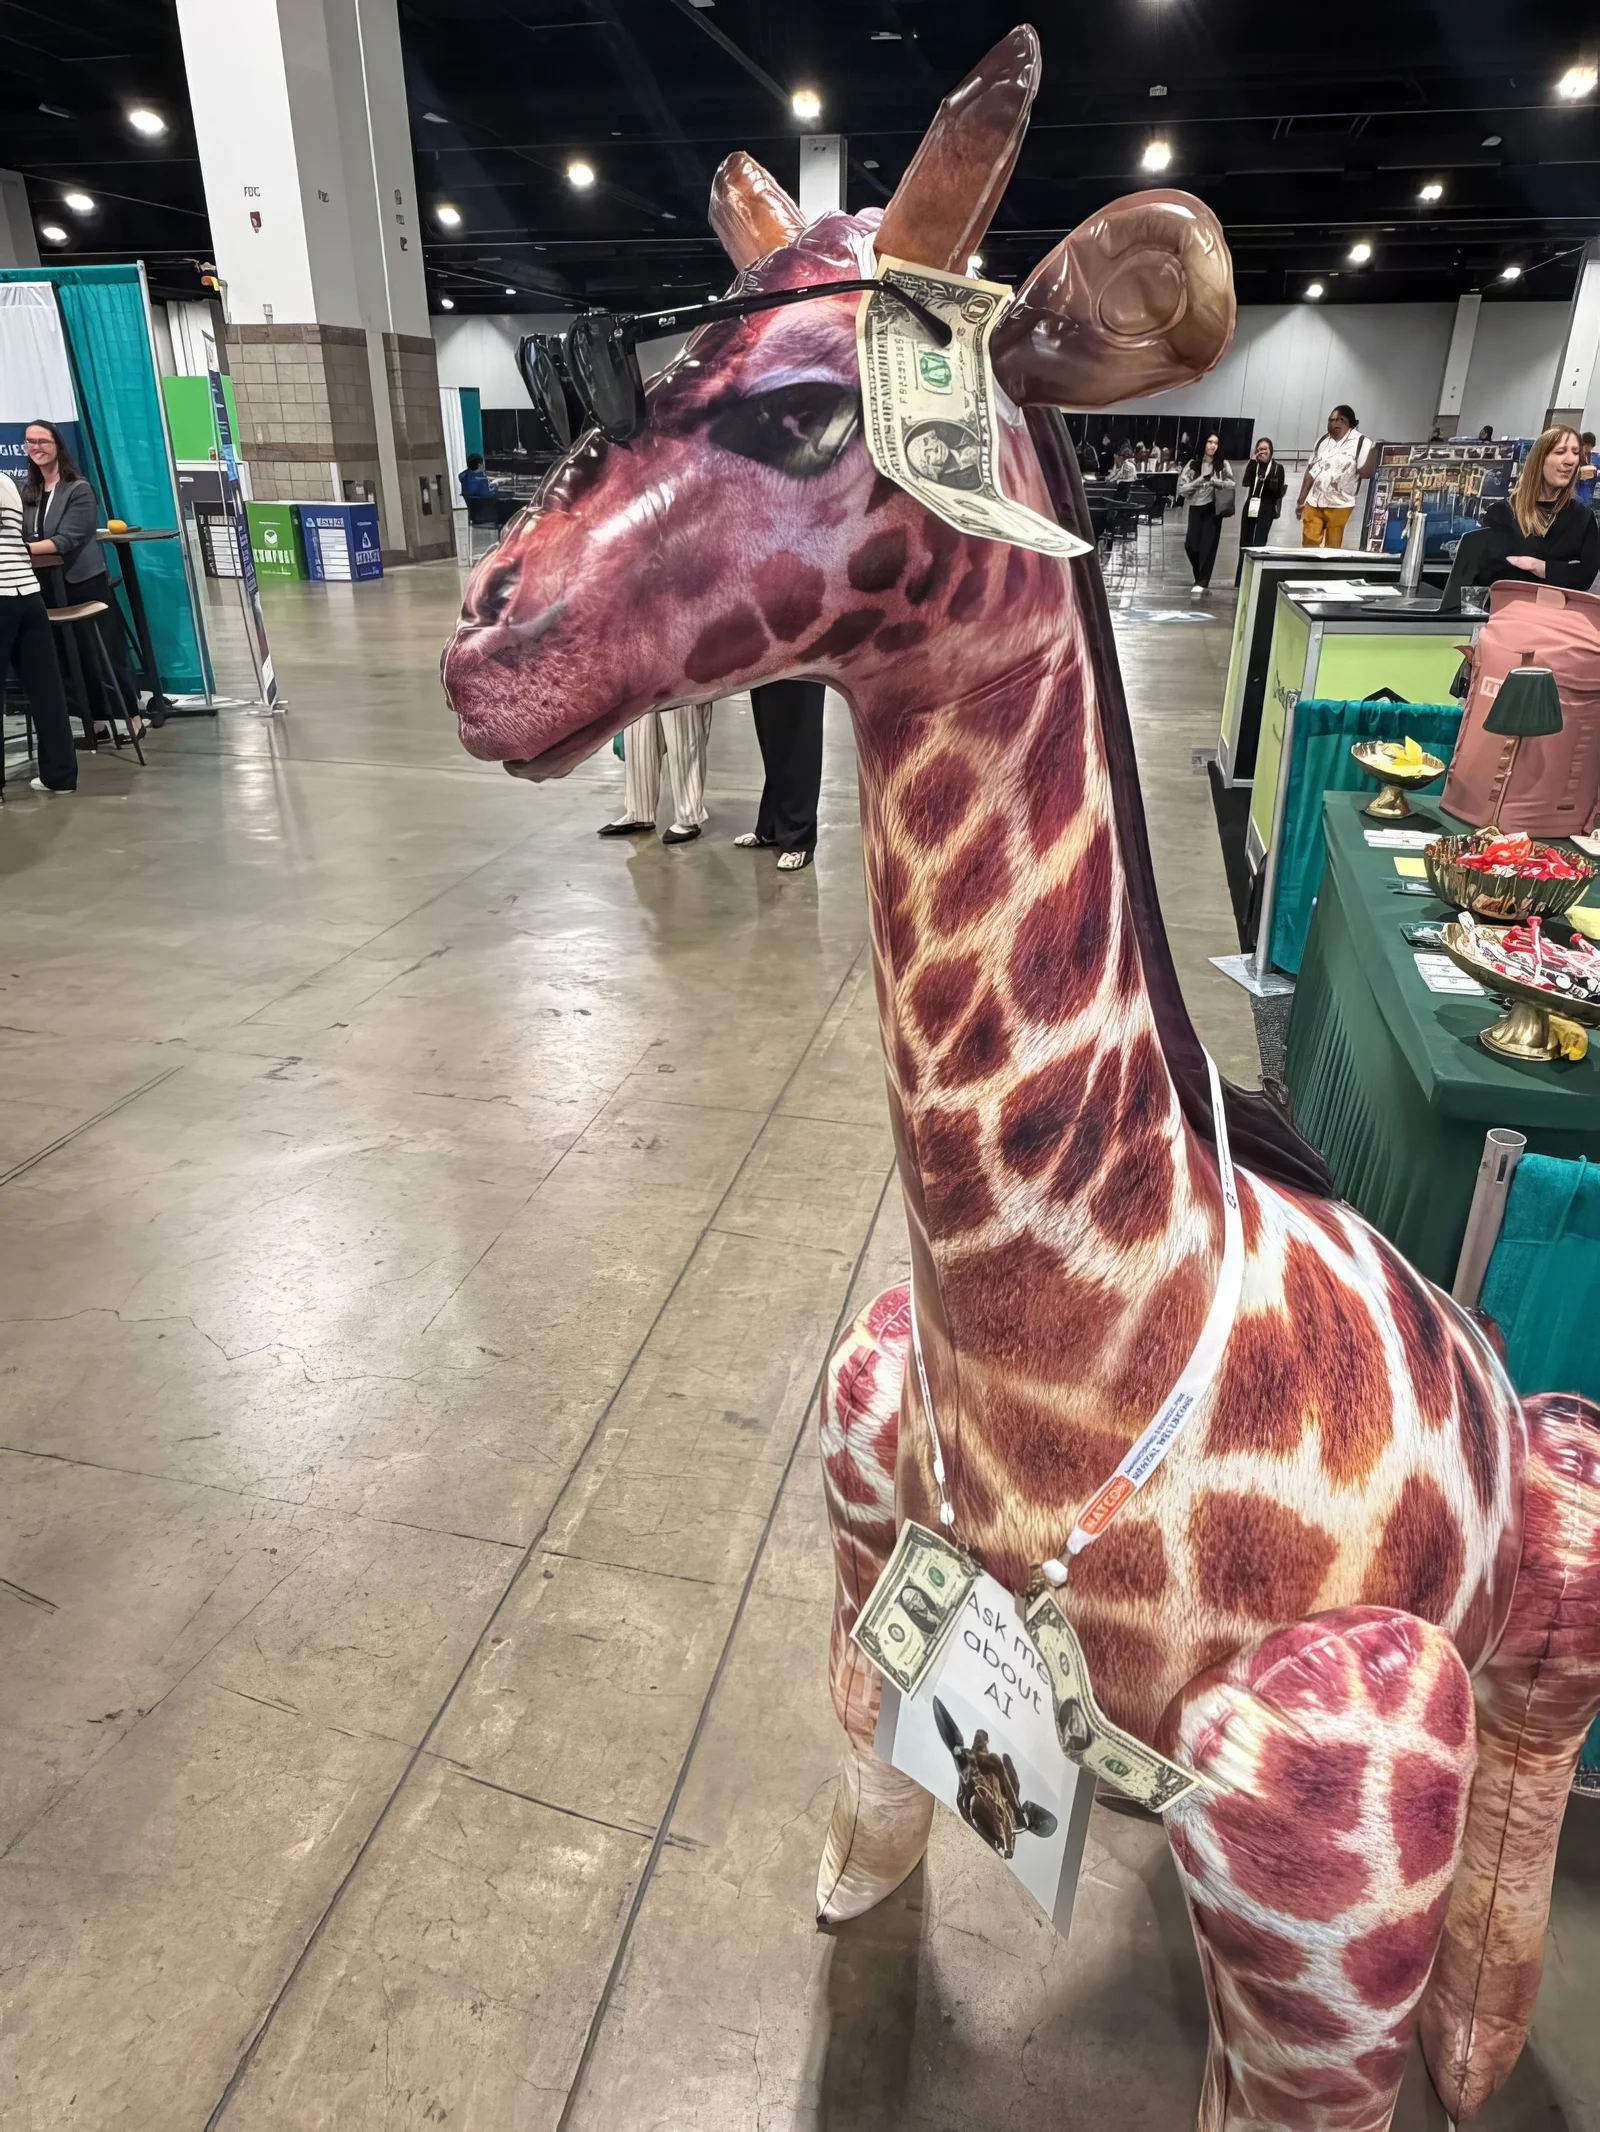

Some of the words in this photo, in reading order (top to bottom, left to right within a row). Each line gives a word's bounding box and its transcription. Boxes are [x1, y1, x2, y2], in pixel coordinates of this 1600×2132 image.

[963, 1629, 1042, 1716] about
[965, 1590, 1008, 1643] Ask
[1013, 1636, 1050, 1686] me
[983, 1681, 1014, 1720] AI
